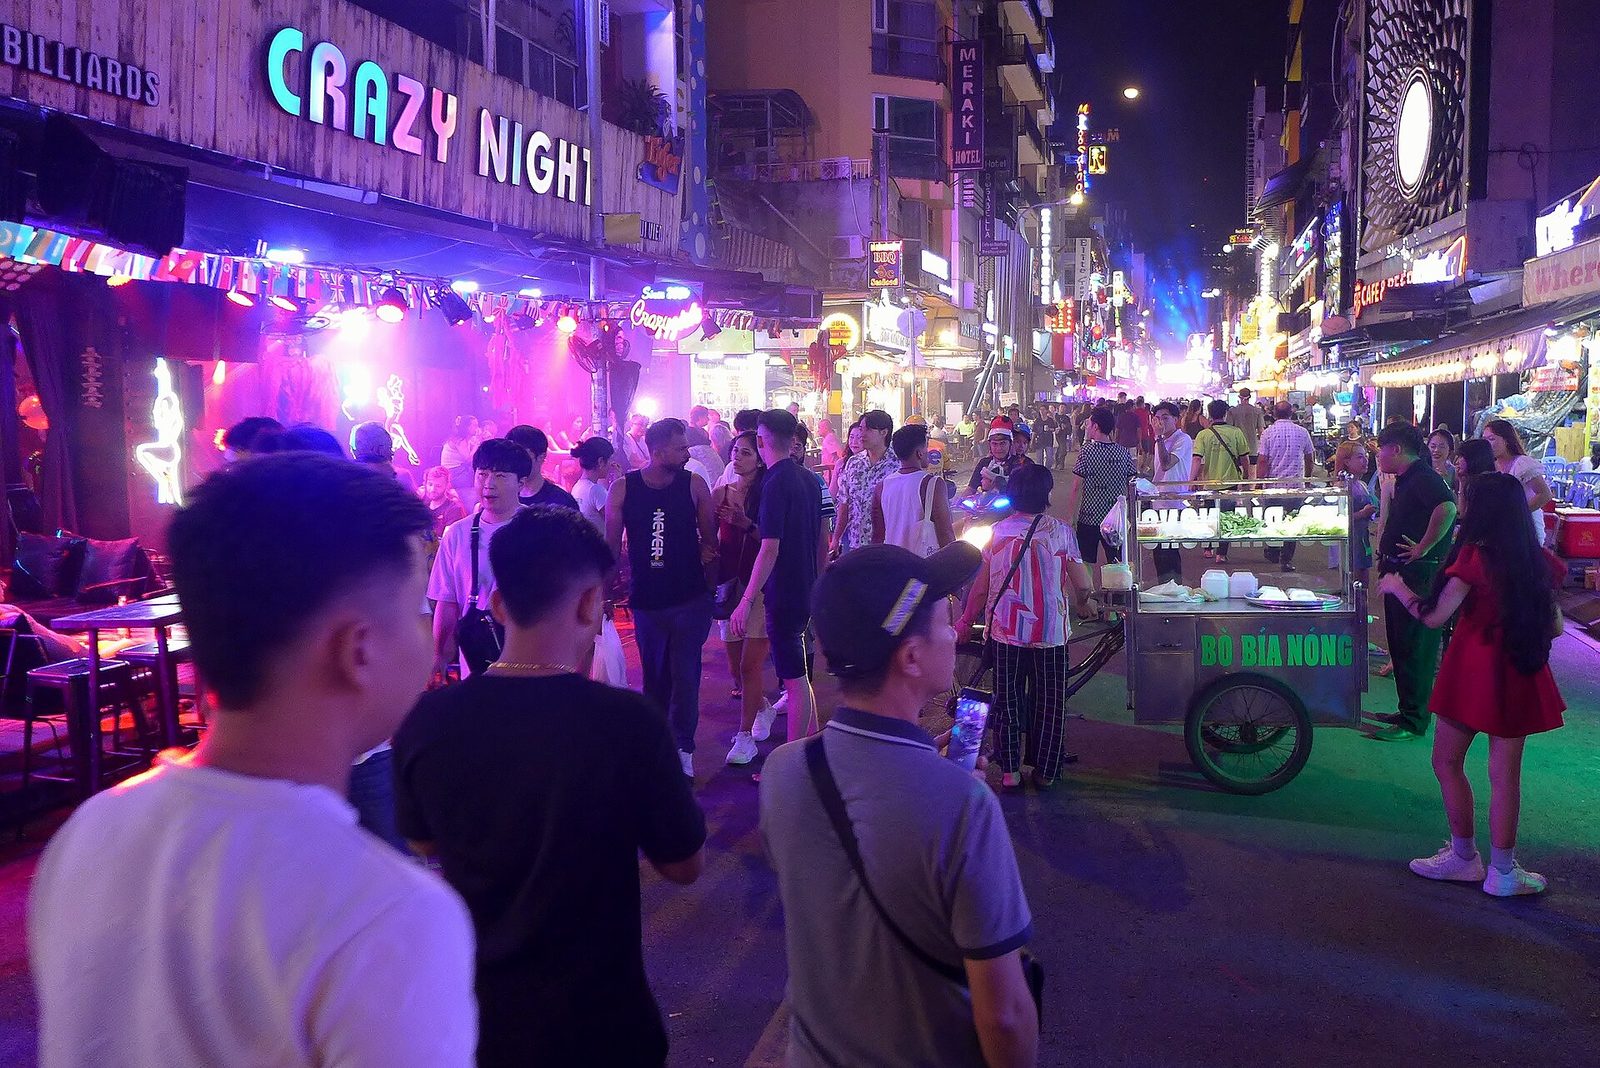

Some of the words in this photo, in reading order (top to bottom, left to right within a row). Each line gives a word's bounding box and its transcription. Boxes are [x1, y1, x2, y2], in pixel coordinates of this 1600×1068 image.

[2, 23, 160, 107] BILLIARDS
[267, 27, 458, 164] CRAZY
[960, 48, 977, 145] MERAKI
[955, 149, 981, 164] HOTEL
[873, 252, 896, 265] BBQ
[1535, 259, 1600, 295] Wher
[1361, 281, 1380, 307] CAFE
[650, 511, 665, 557] NEVER
[1201, 627, 1233, 667] BÒ
[1241, 626, 1283, 667] BÍA
[1287, 626, 1353, 667] NÓNG
